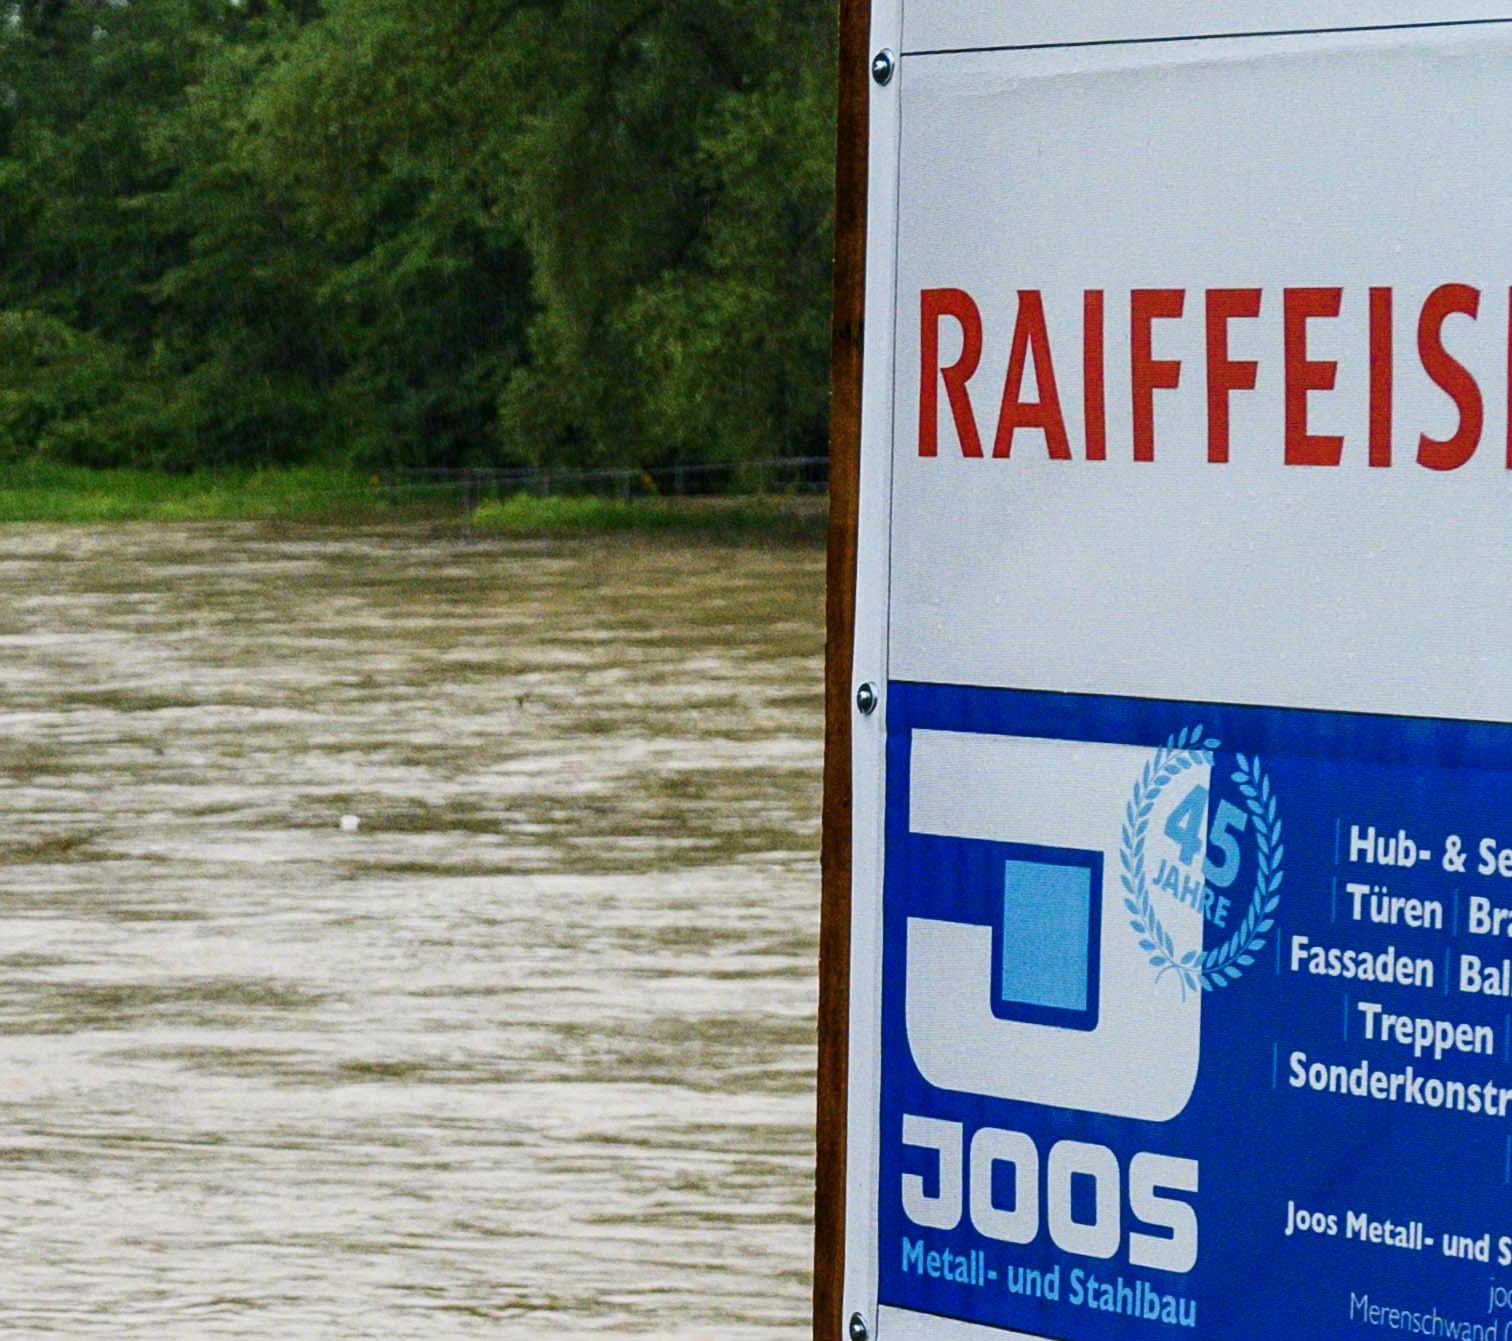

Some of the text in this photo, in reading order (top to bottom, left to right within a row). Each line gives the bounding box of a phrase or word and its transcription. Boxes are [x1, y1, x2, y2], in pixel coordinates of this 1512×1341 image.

[918, 283, 1512, 471] RAIFFEIS
[1164, 784, 1248, 887] 45
[1349, 824, 1431, 868] Hub-
[1442, 834, 1467, 873] &
[1153, 858, 1231, 928] JAHRE
[1346, 882, 1512, 937] Türen Br
[1290, 935, 1434, 988] Fassaden
[1357, 1001, 1494, 1060] Treppen
[1289, 1051, 1512, 1117] Sonderkonstr
[902, 1113, 1199, 1273] JOOS
[1284, 1200, 1338, 1236] Joos
[1345, 1210, 1434, 1250] Metall-
[1442, 1233, 1490, 1262] und
[901, 1236, 1196, 1327] Metall- und Stahlbau
